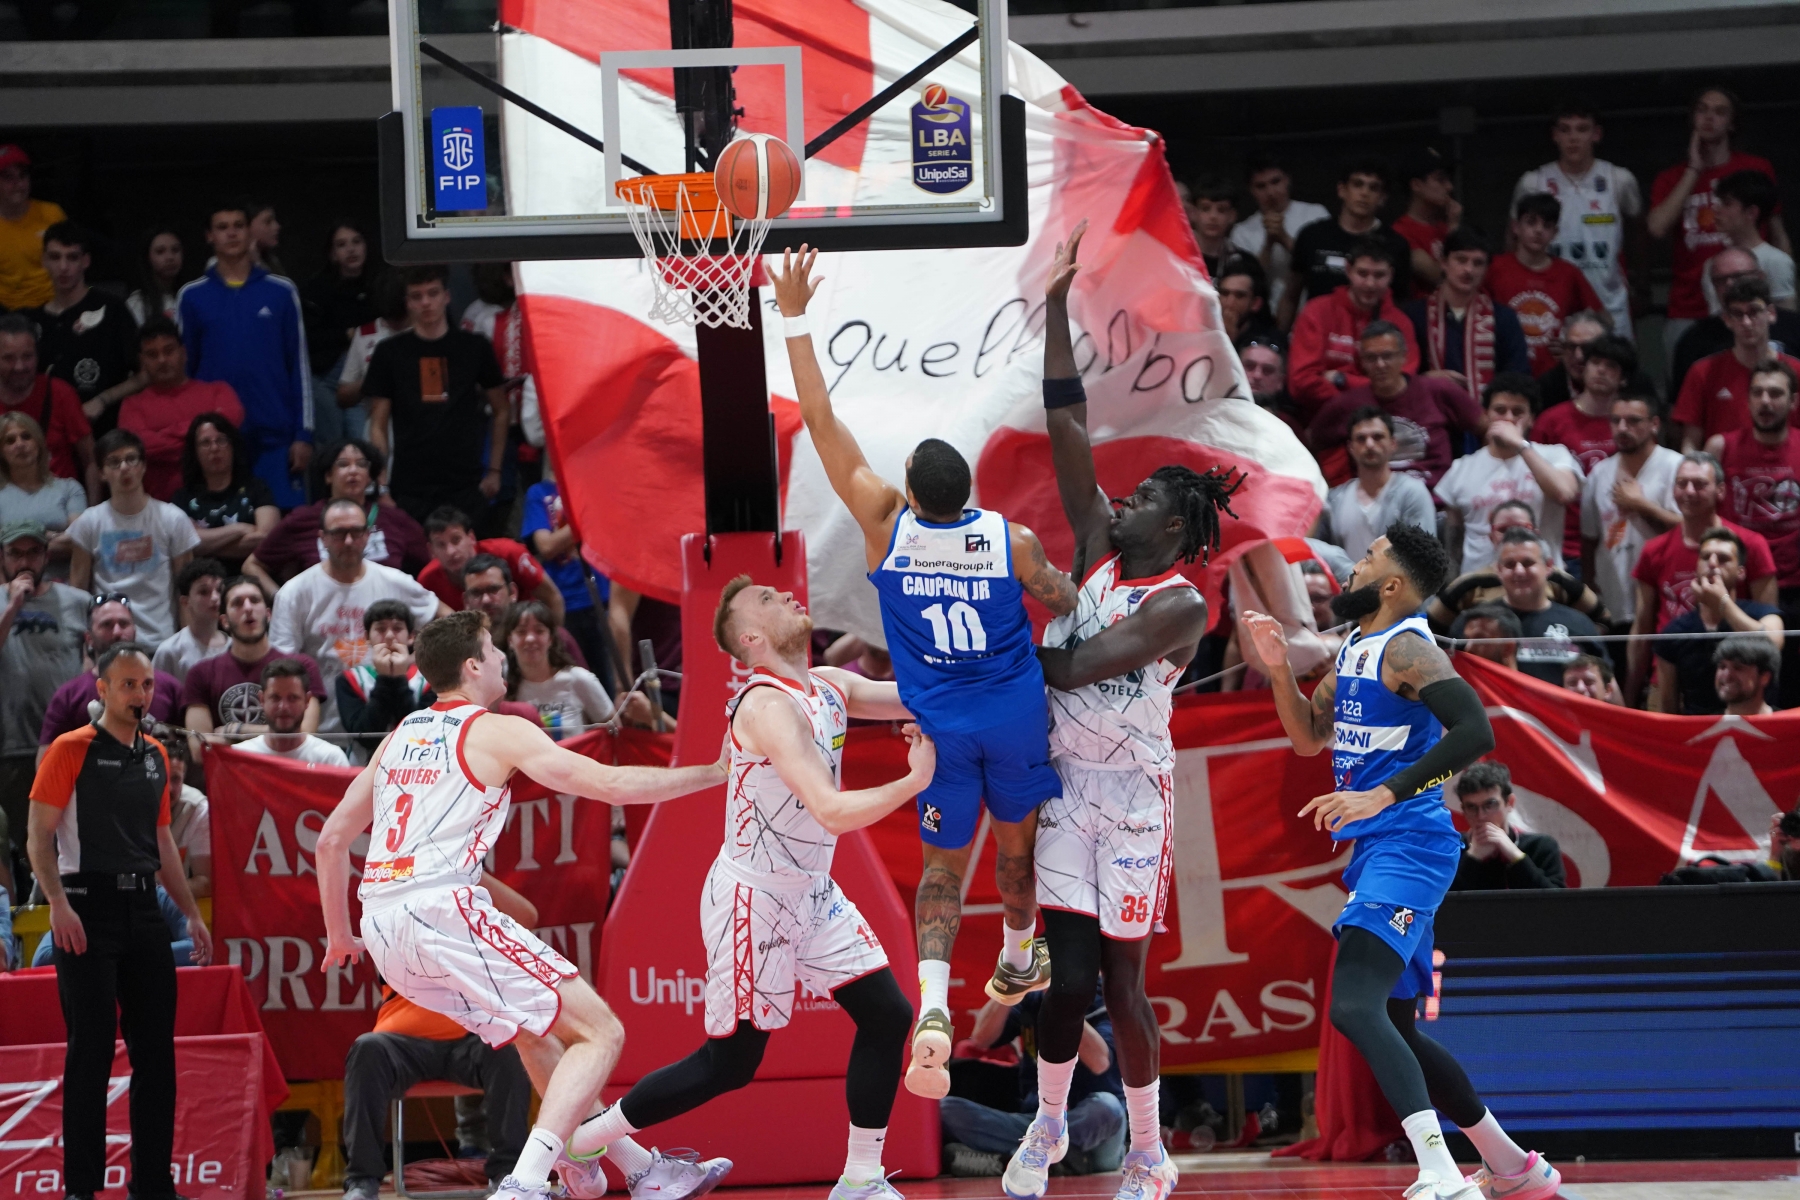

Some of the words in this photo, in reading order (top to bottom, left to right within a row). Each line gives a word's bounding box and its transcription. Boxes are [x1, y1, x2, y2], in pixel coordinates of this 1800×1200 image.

[919, 129, 966, 148] LBA
[951, 149, 958, 157] A
[440, 175, 481, 191] FIP
[919, 166, 968, 183] UnipolSai
[914, 559, 994, 572] boneragroup.it
[902, 575, 969, 601] CAUPAIN
[972, 579, 990, 600] JR
[921, 601, 987, 655] 10
[1094, 682, 1144, 698] OTELS
[1342, 700, 1362, 717] a2a
[386, 767, 442, 786] REUVERS
[386, 794, 414, 853] 3
[244, 795, 578, 876] ASTI
[1120, 894, 1148, 923] 35
[629, 967, 704, 1015] Unip
